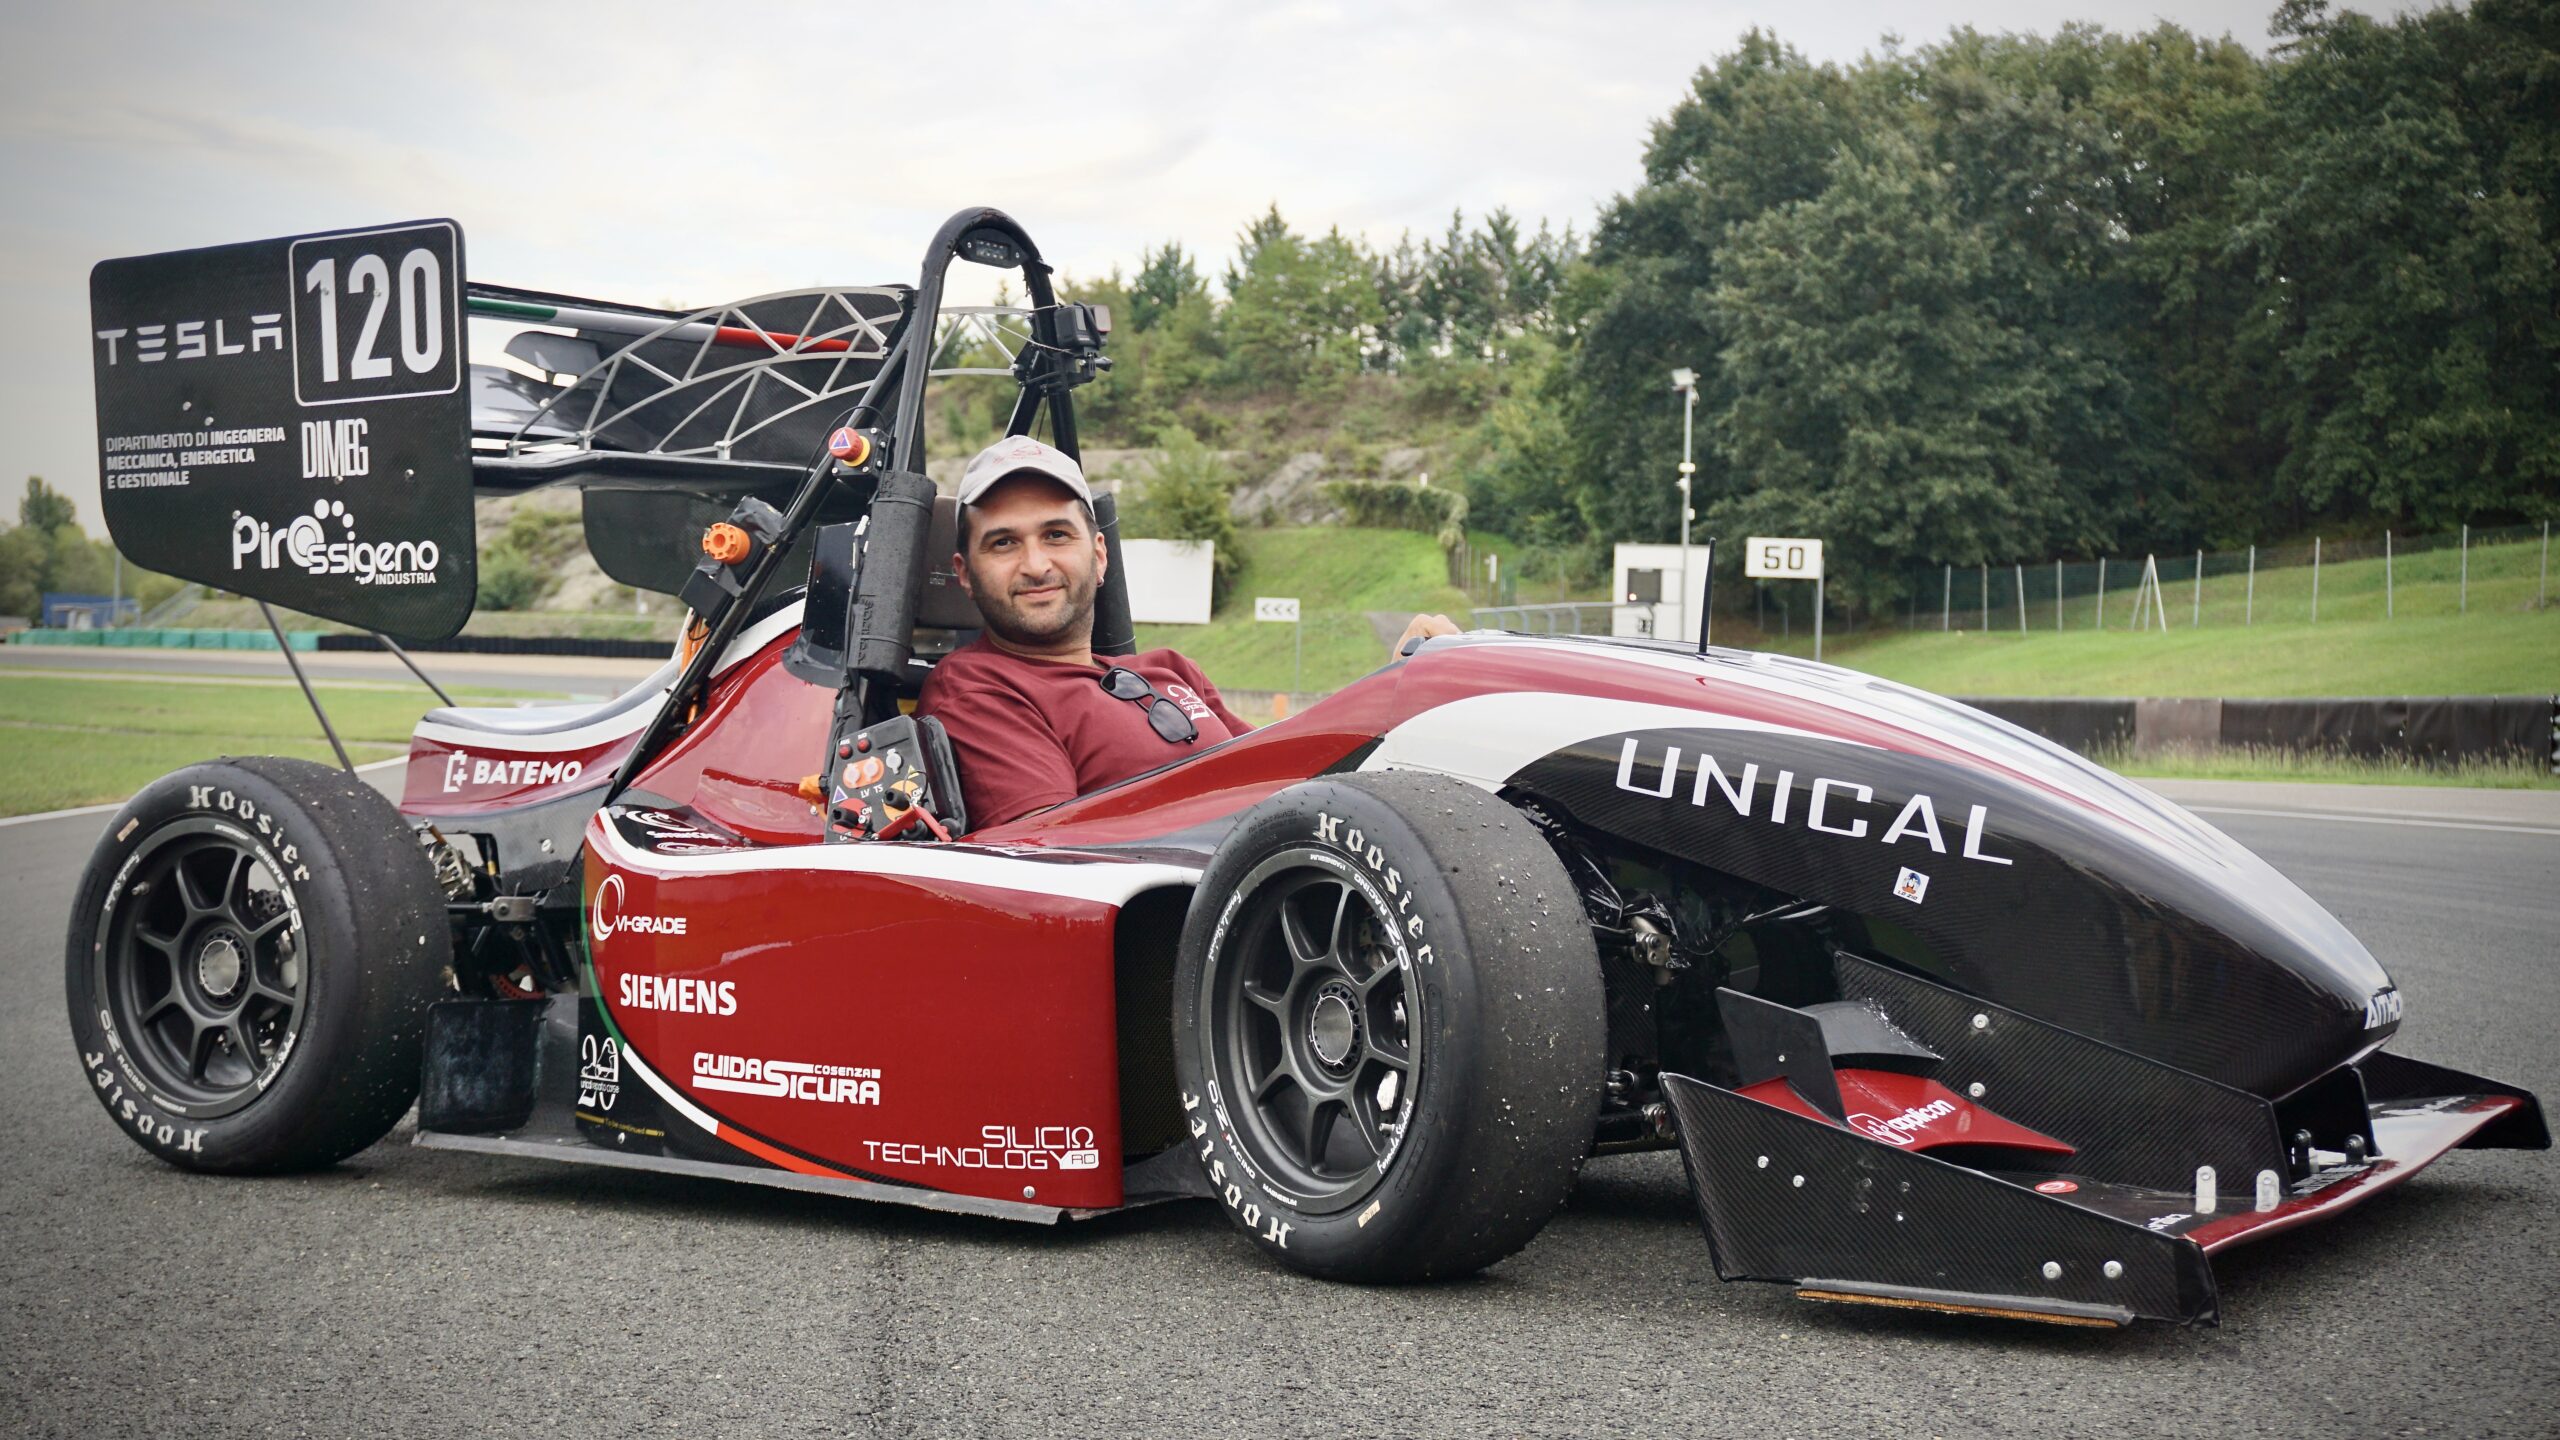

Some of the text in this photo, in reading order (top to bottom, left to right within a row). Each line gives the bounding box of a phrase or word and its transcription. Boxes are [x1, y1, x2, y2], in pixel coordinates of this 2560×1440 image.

[306, 248, 442, 383] 120
[97, 313, 283, 366] TESLA
[106, 427, 286, 452] DIPARTIMENTO DI INGEGNERIA
[107, 448, 256, 471] MECCANICA, ENERGETICA
[107, 471, 190, 489] E GESTIONALE
[1764, 546, 1804, 570] 50
[375, 572, 437, 585] INDUSTRIA
[472, 760, 582, 784] BATEMO
[1616, 737, 2013, 865] UNICAL
[189, 785, 310, 881] Hoosier
[1312, 812, 1434, 966] Hoosier
[616, 915, 687, 934] VI-GRADE
[620, 973, 737, 1016] SIEMENS
[814, 1063, 871, 1078] COSENZA
[86, 1051, 208, 1152] Hoosier
[1887, 1099, 1956, 1131] applicon
[863, 1140, 1068, 1169] TECHNOLOGY
[1182, 1091, 1296, 1249] Hoosier
[1226, 1134, 1256, 1179] RACING
